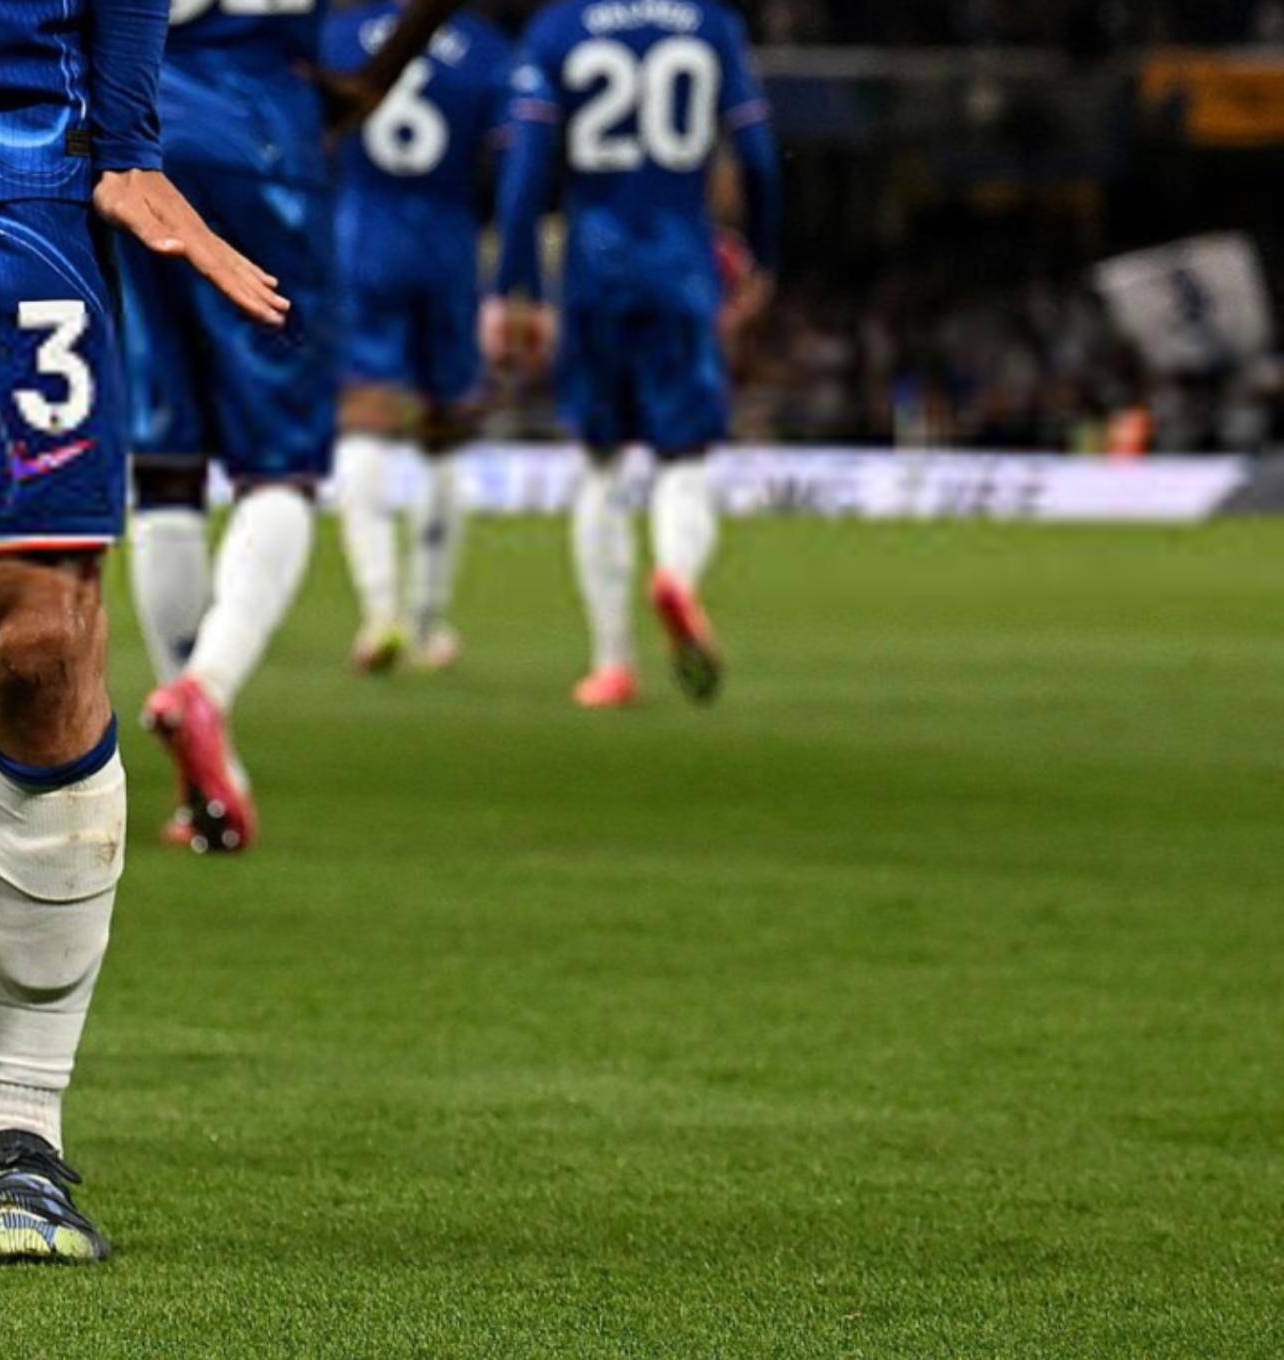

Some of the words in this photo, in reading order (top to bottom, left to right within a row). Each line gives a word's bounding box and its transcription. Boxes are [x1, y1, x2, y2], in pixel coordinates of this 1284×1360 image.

[362, 56, 450, 176] 6
[564, 36, 720, 172] 20
[13, 300, 94, 434] 3
